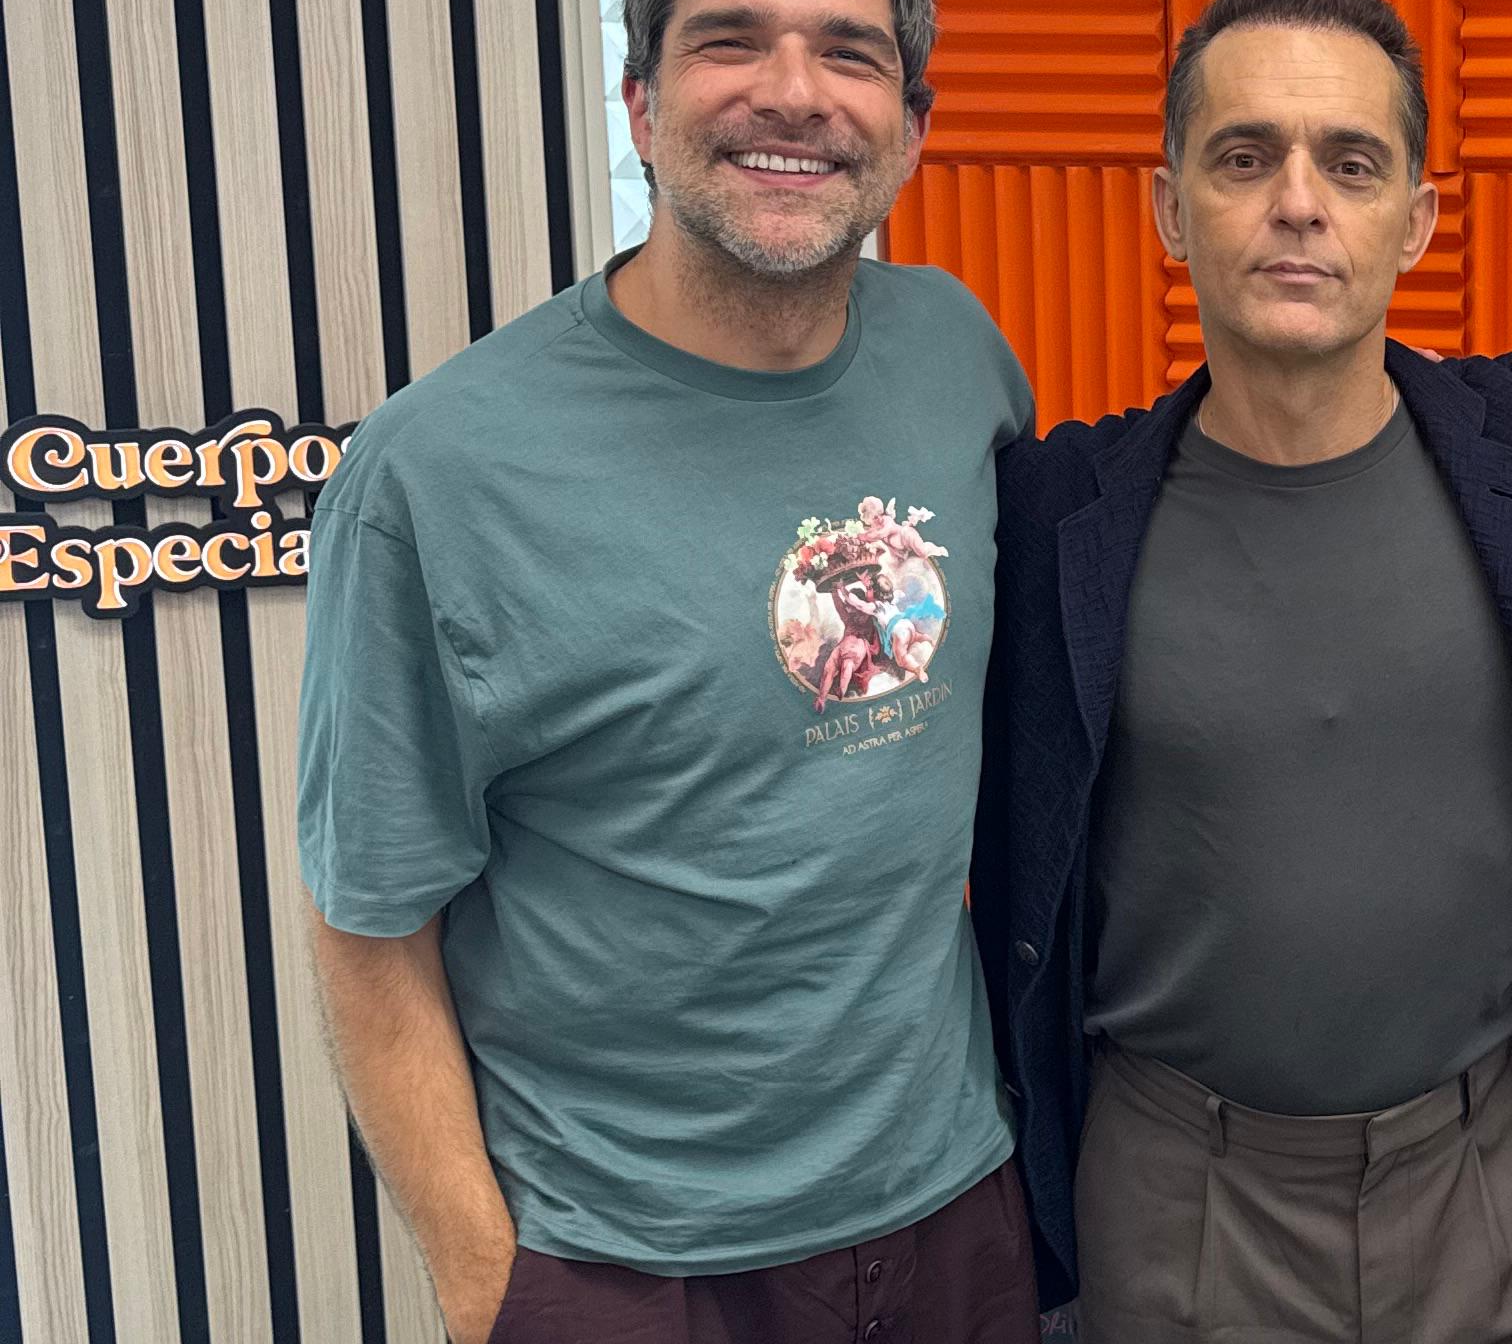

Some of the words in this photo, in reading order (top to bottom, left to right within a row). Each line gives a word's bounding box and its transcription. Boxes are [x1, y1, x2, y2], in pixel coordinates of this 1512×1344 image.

[7, 420, 352, 507] Cuerpo
[0, 511, 312, 609] Especia
[804, 713, 860, 747] PALAIS
[909, 680, 953, 720] JARDIN
